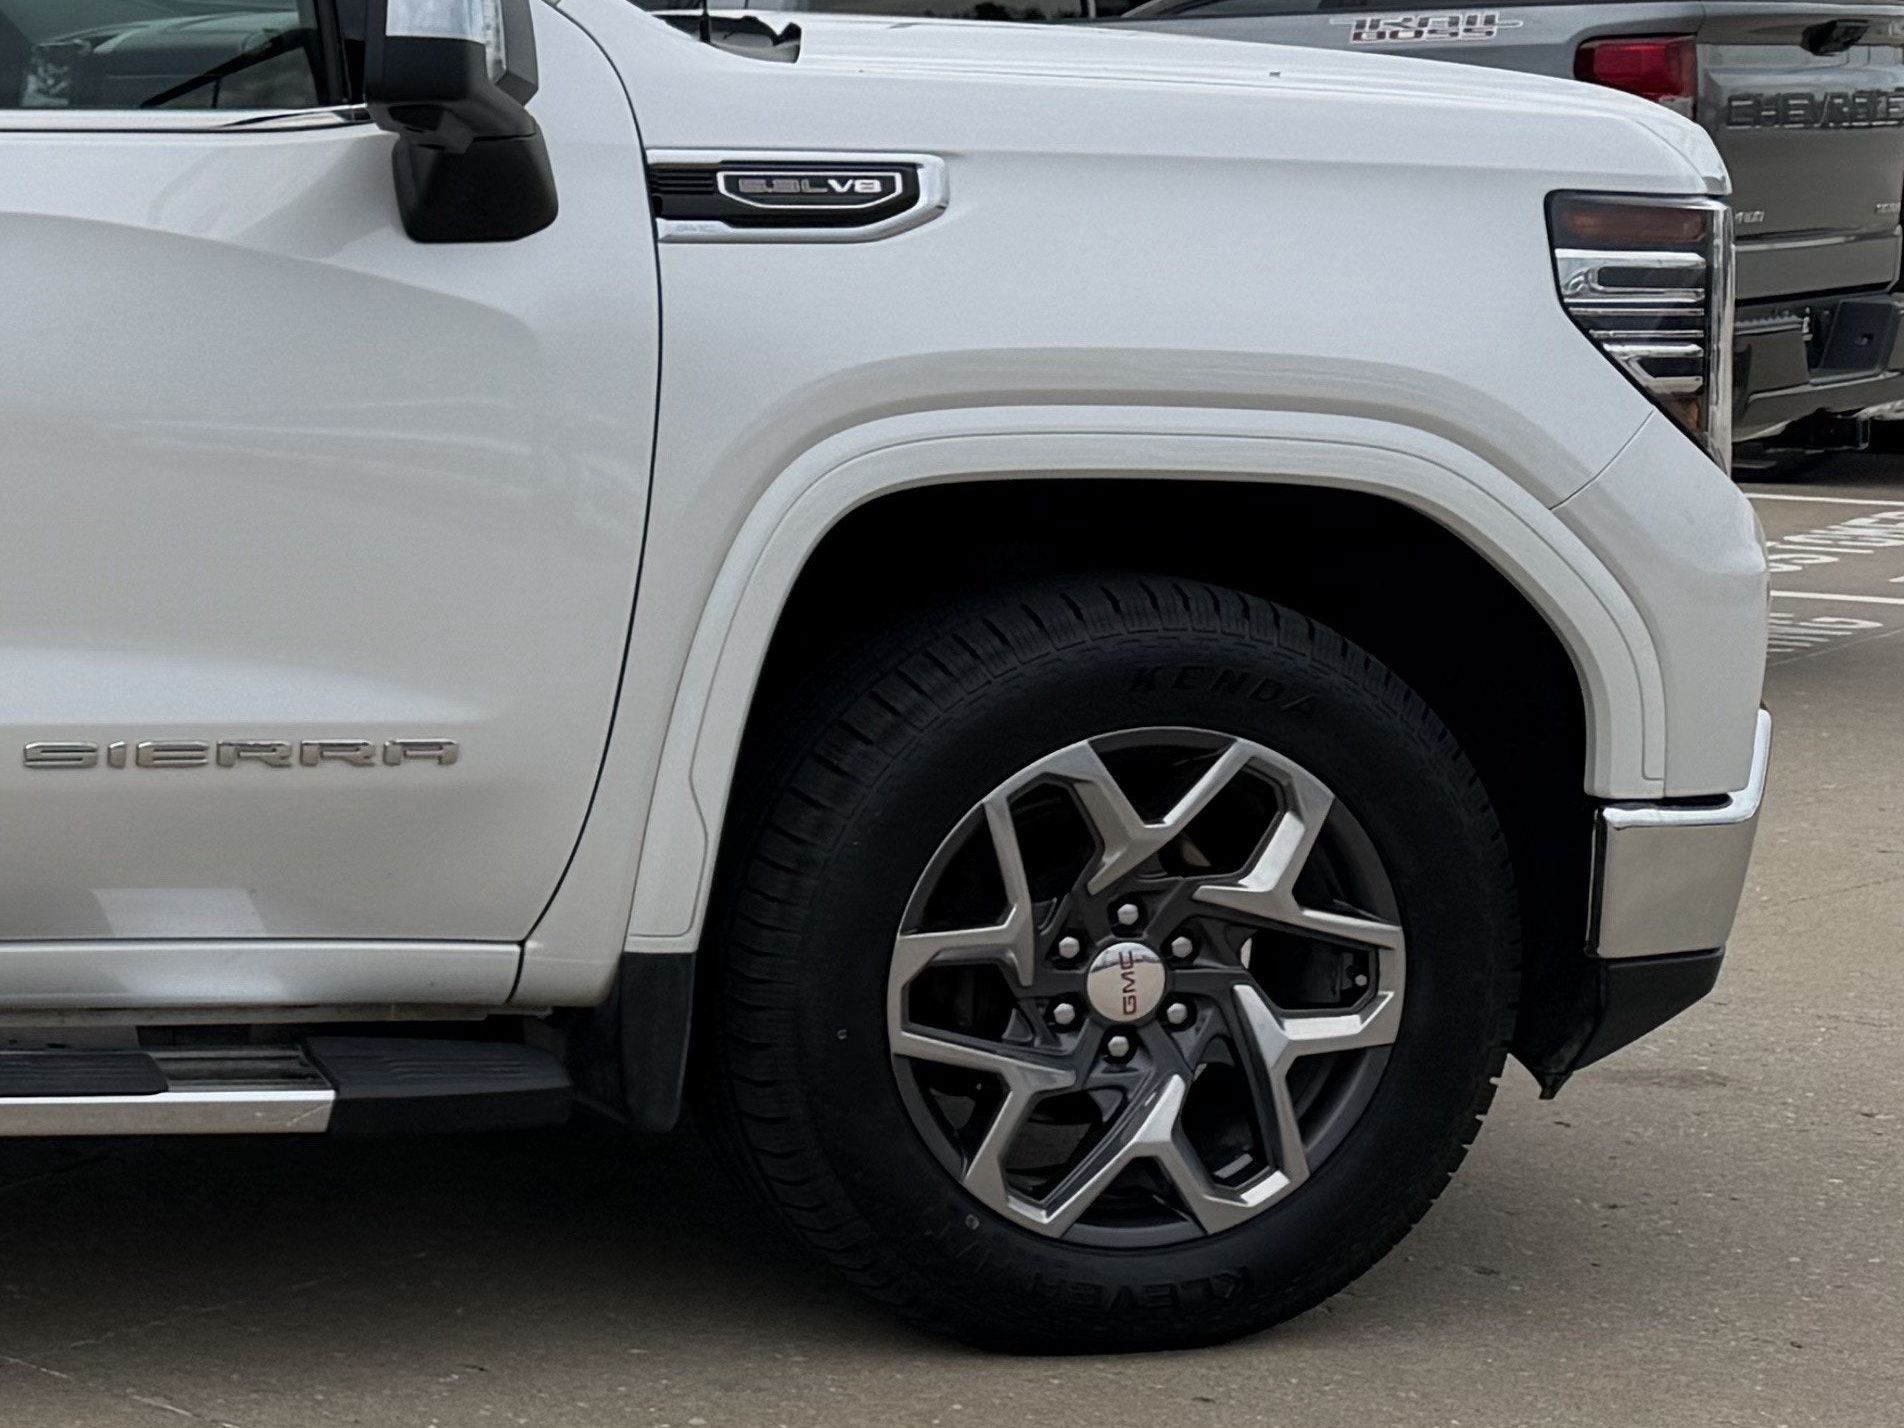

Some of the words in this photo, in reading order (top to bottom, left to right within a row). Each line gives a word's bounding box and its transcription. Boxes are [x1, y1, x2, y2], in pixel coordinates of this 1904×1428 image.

[1128, 667, 1313, 716] KENDA
[23, 739, 460, 769] SIERRA
[1118, 951, 1137, 1015] GMC
